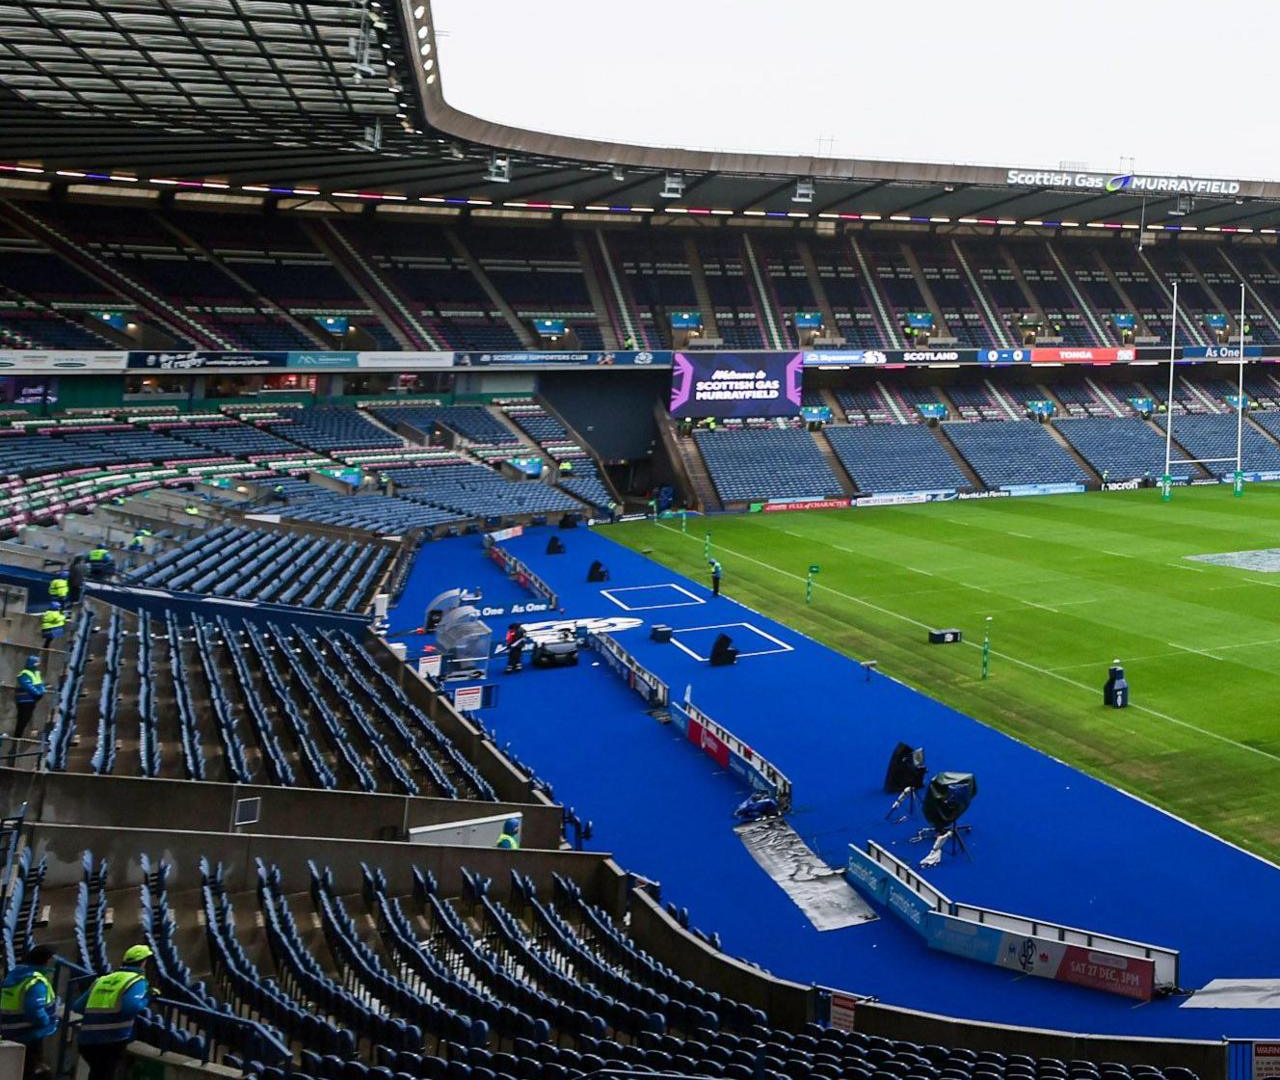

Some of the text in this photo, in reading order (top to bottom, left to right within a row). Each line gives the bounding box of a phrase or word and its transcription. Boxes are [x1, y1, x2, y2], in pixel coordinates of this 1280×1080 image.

[1007, 171, 1240, 194] Scottish Gas MURRAYFIELD
[903, 352, 959, 361] SCOTLAND
[988, 350, 998, 361] 0
[1013, 350, 1022, 361] 0
[1059, 351, 1092, 359] TONGA
[1205, 347, 1239, 357] As One
[696, 380, 780, 391] SCOTTISH GAS
[696, 389, 779, 400] MURRAYFIELD
[1101, 481, 1138, 491] macron
[483, 607, 504, 616] One
[511, 603, 547, 613] As One
[1071, 960, 1139, 986] SAT 27 DEC, 3PM
